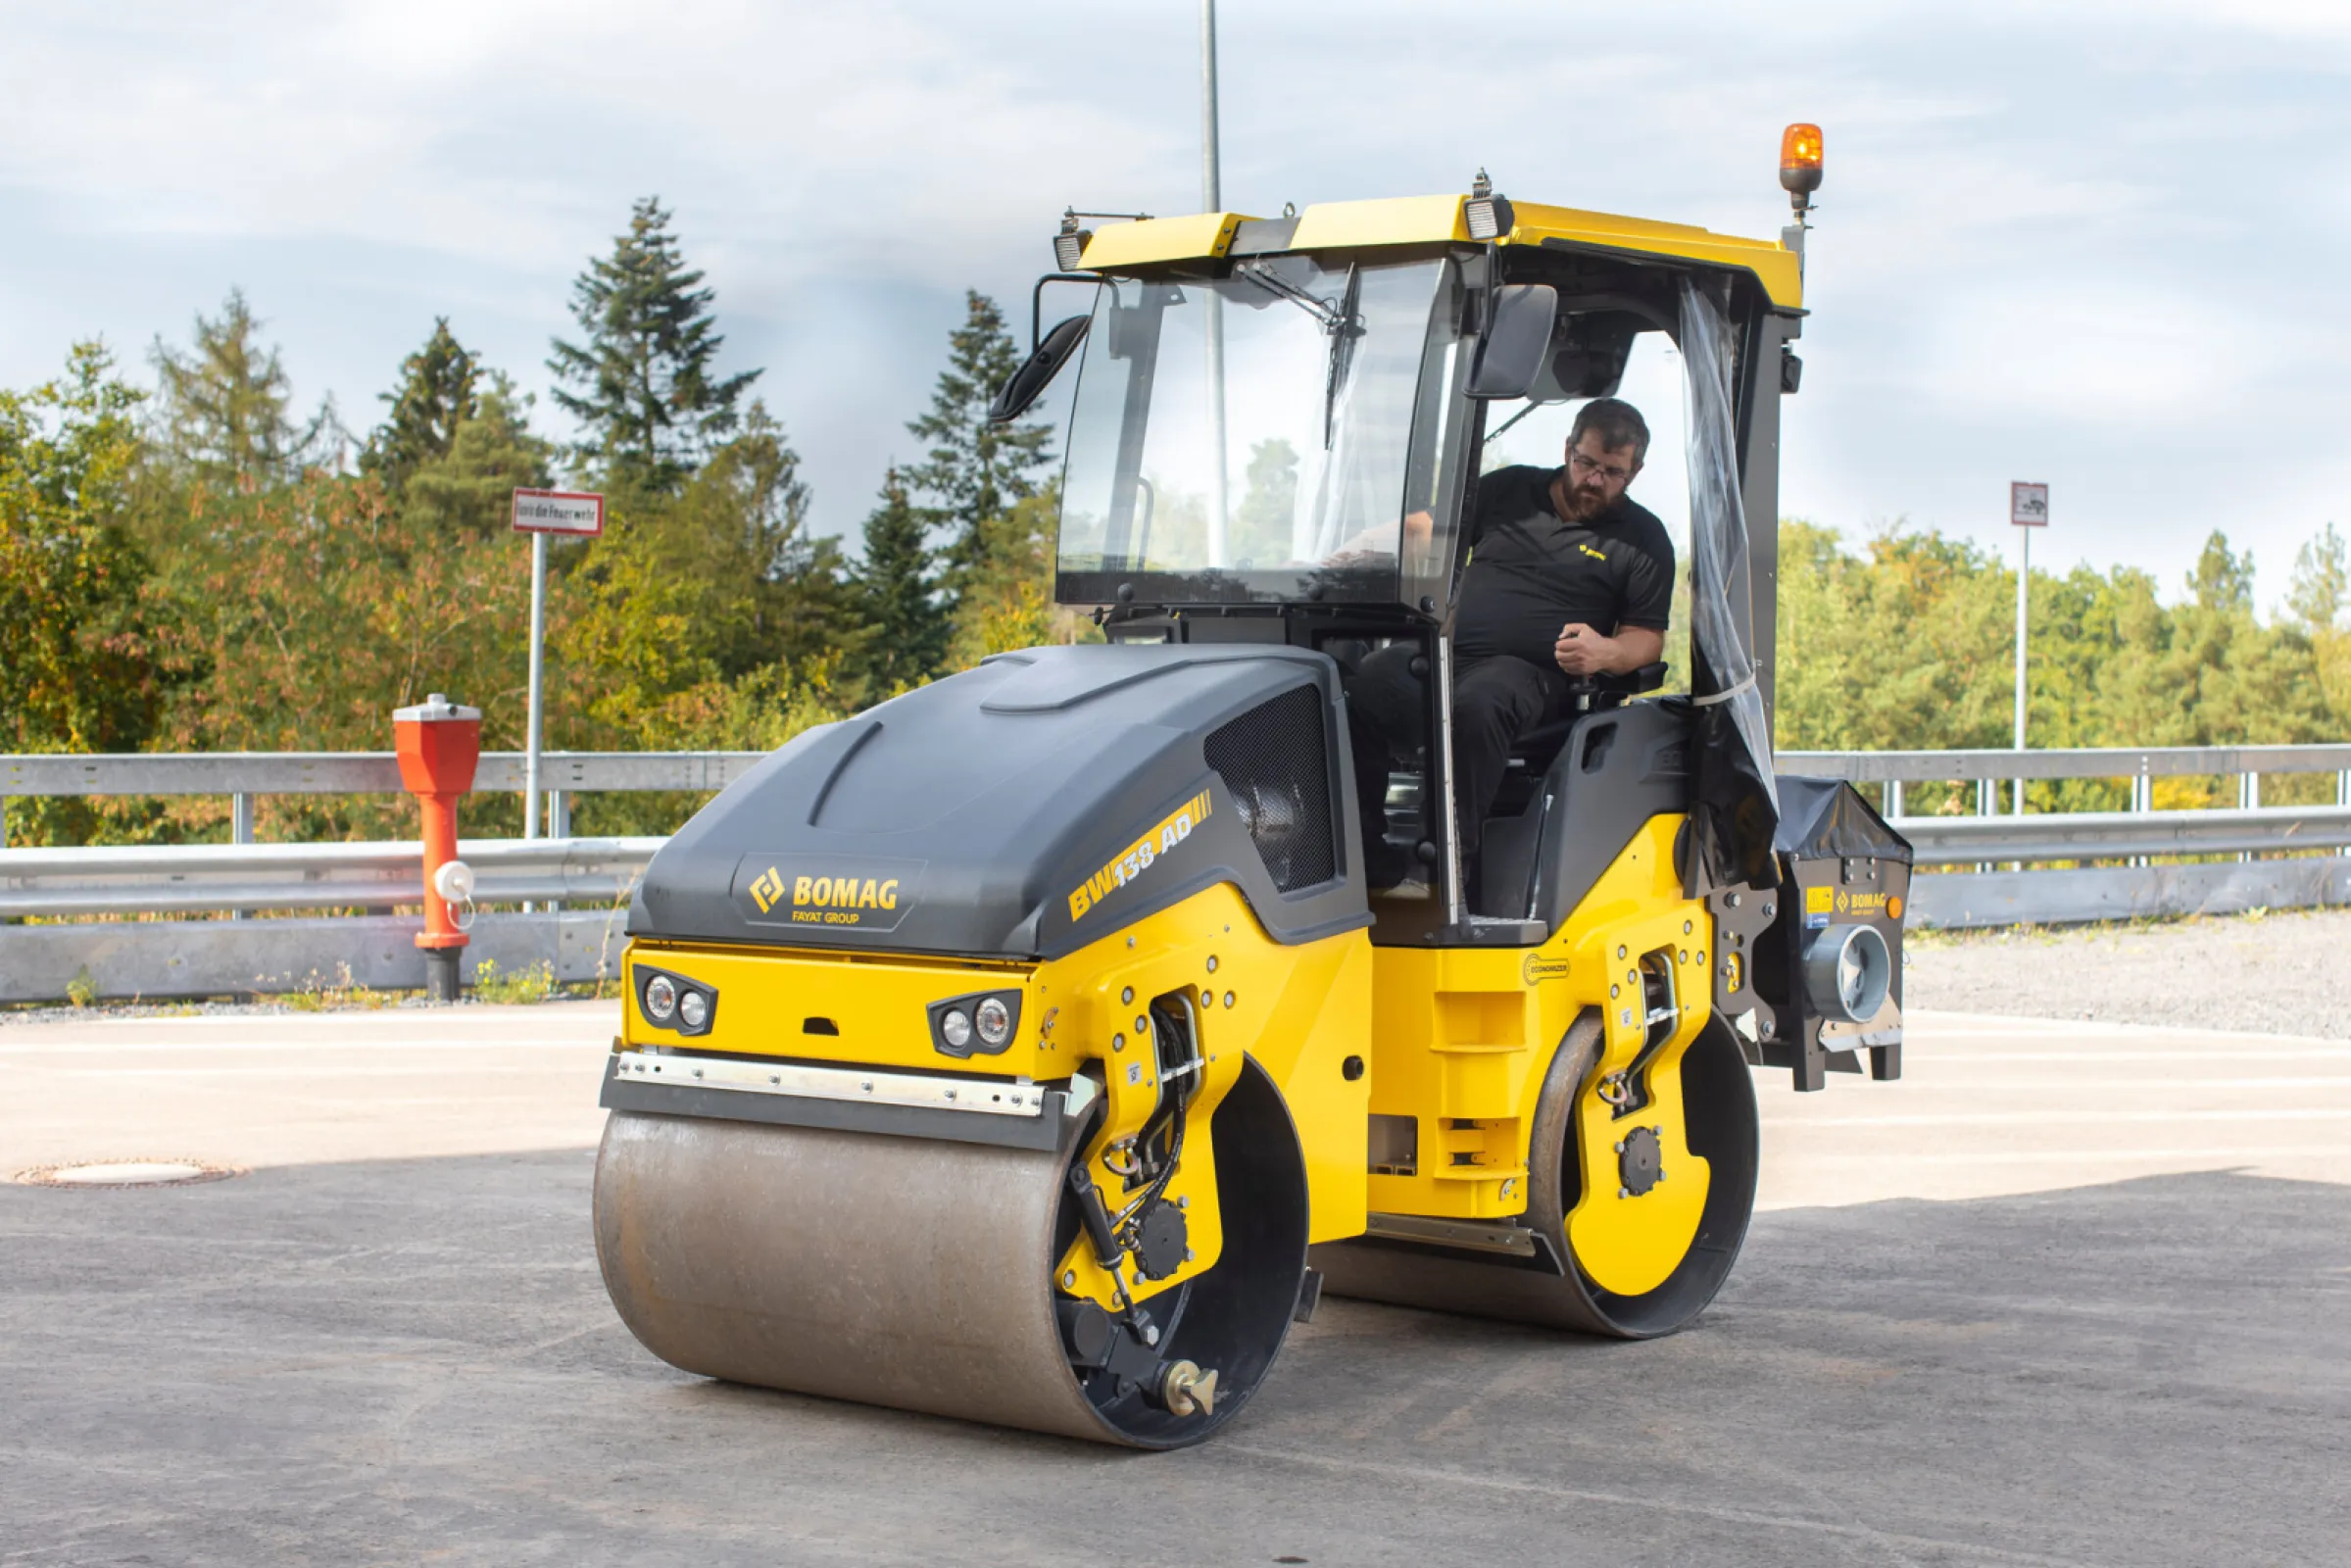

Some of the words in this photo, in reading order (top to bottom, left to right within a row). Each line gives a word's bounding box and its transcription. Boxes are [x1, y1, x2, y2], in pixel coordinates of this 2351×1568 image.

[1068, 863, 1114, 922] BW
[1114, 841, 1154, 888] 138
[1161, 812, 1193, 855] AD
[793, 876, 899, 909] BOMAG
[1850, 892, 1886, 907] BOMAG
[792, 910, 823, 922] FAYAT
[824, 911, 859, 924] GROUP
